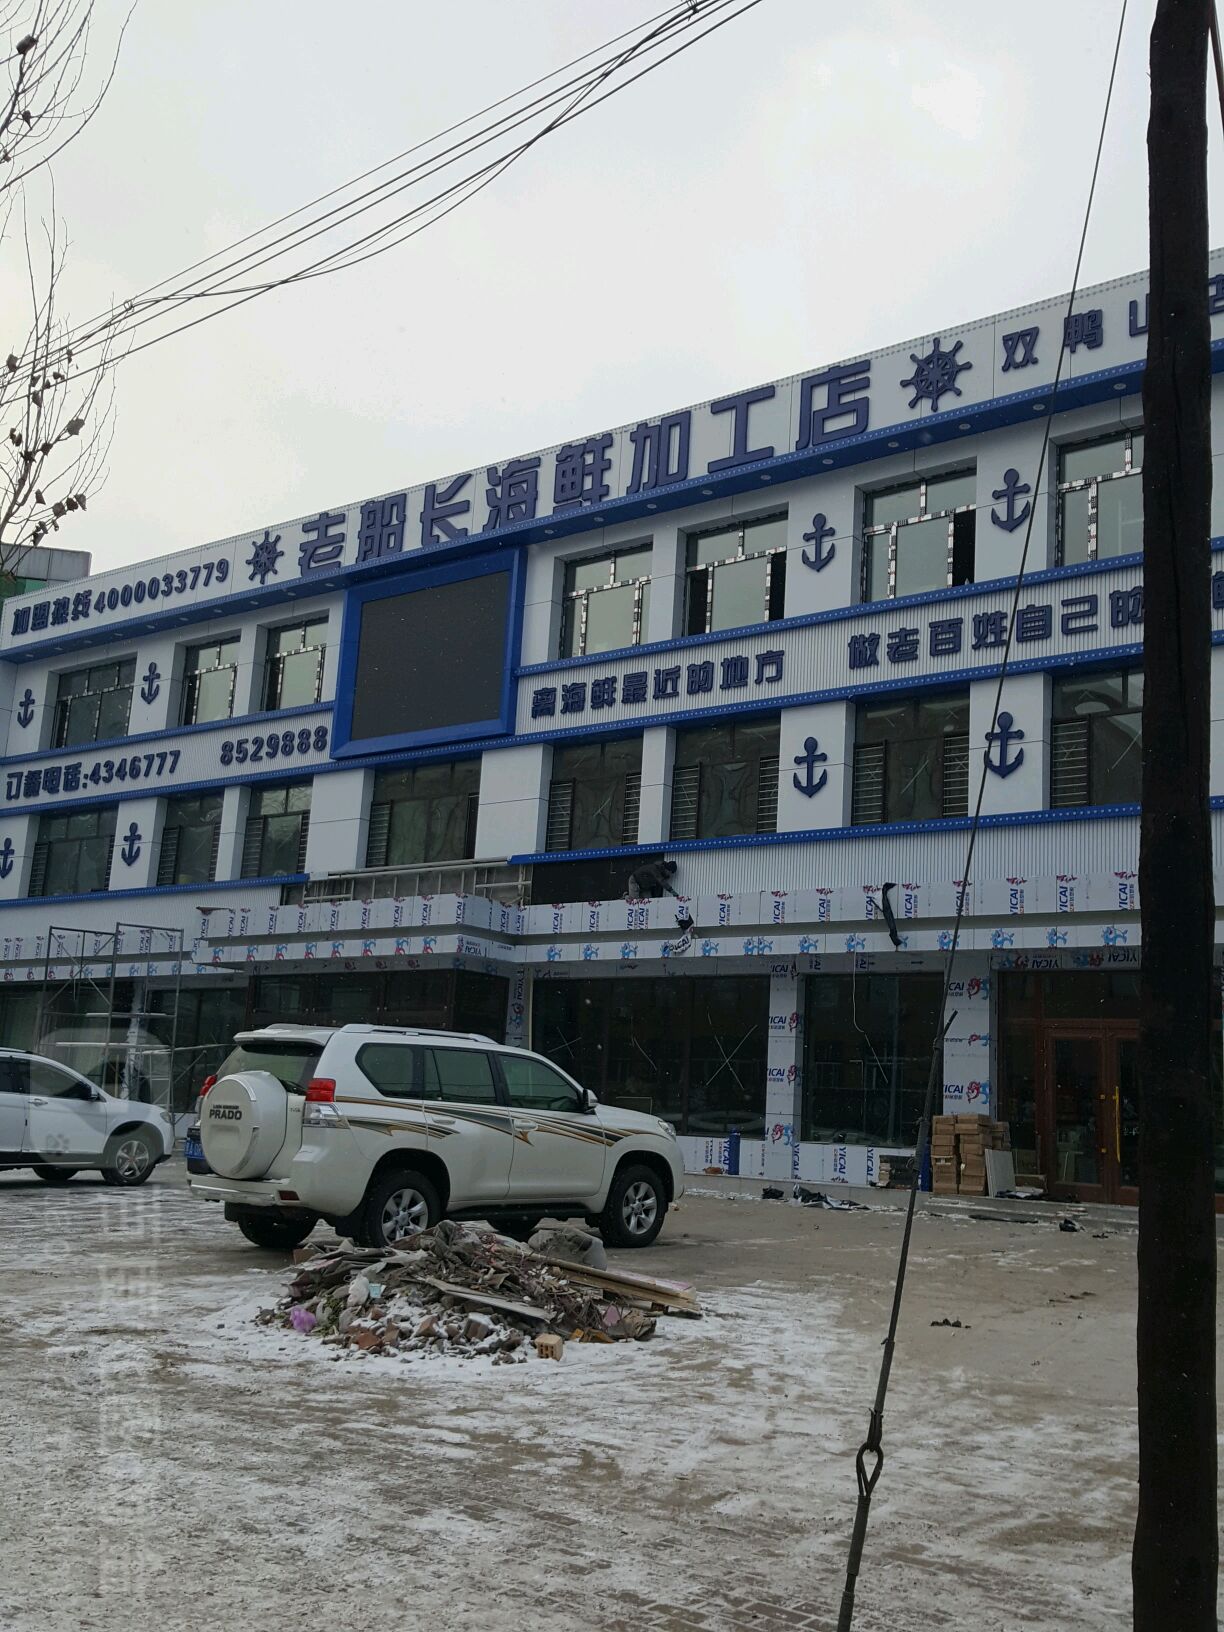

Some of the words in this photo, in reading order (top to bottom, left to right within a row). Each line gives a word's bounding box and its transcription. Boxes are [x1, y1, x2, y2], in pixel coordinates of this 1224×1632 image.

[298, 359, 871, 577] 老船长海鲜加工店
[532, 650, 784, 719] 离海鲜最近的地方
[220, 726, 328, 766] 8529888
[767, 1068, 786, 1077] ICAI
[943, 1084, 964, 1094] ICAI
[209, 1109, 242, 1120] PRADO
[839, 1146, 847, 1175] YICAI
